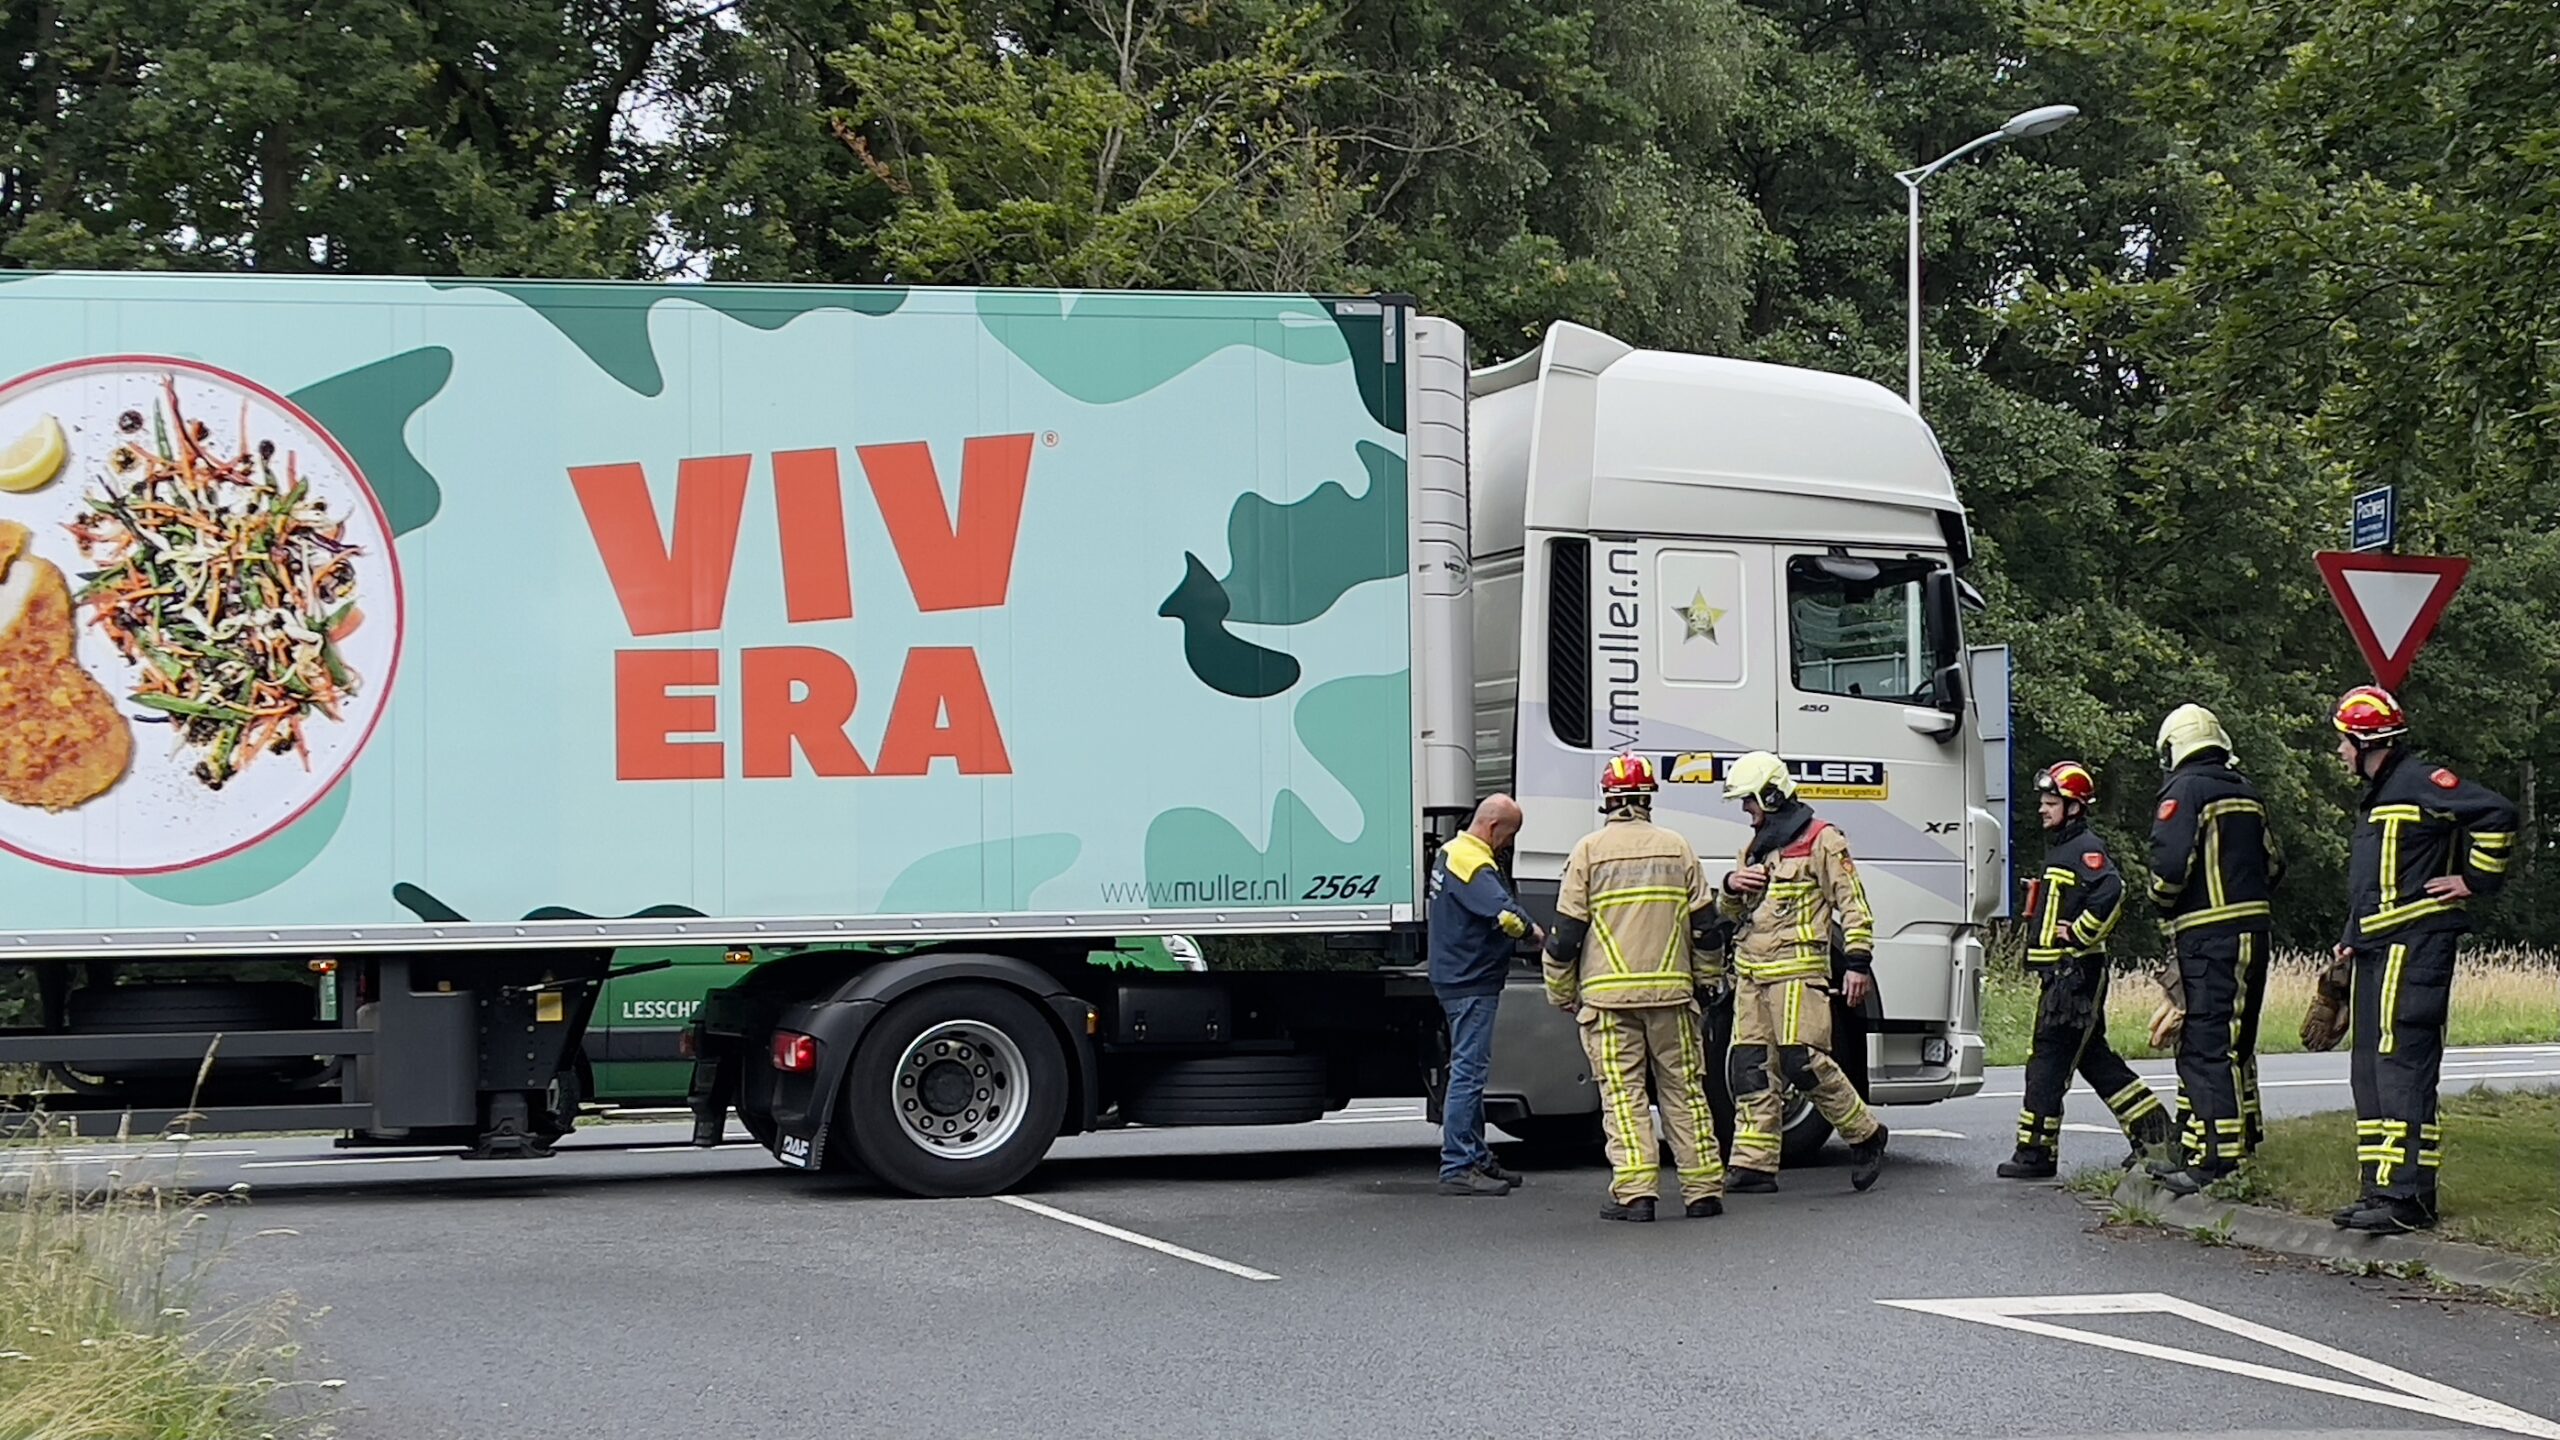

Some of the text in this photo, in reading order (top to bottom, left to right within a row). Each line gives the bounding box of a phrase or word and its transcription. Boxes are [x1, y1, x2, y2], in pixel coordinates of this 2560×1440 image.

[567, 433, 1034, 636] VIV
[615, 646, 1013, 780] ERA
[1799, 704, 1830, 713] 450
[1816, 787, 1840, 795] Food
[1843, 788, 1882, 797] Logistics
[1924, 822, 1961, 834] XF
[1100, 873, 1287, 903] www.muller.nl
[1302, 874, 1381, 900] 2564
